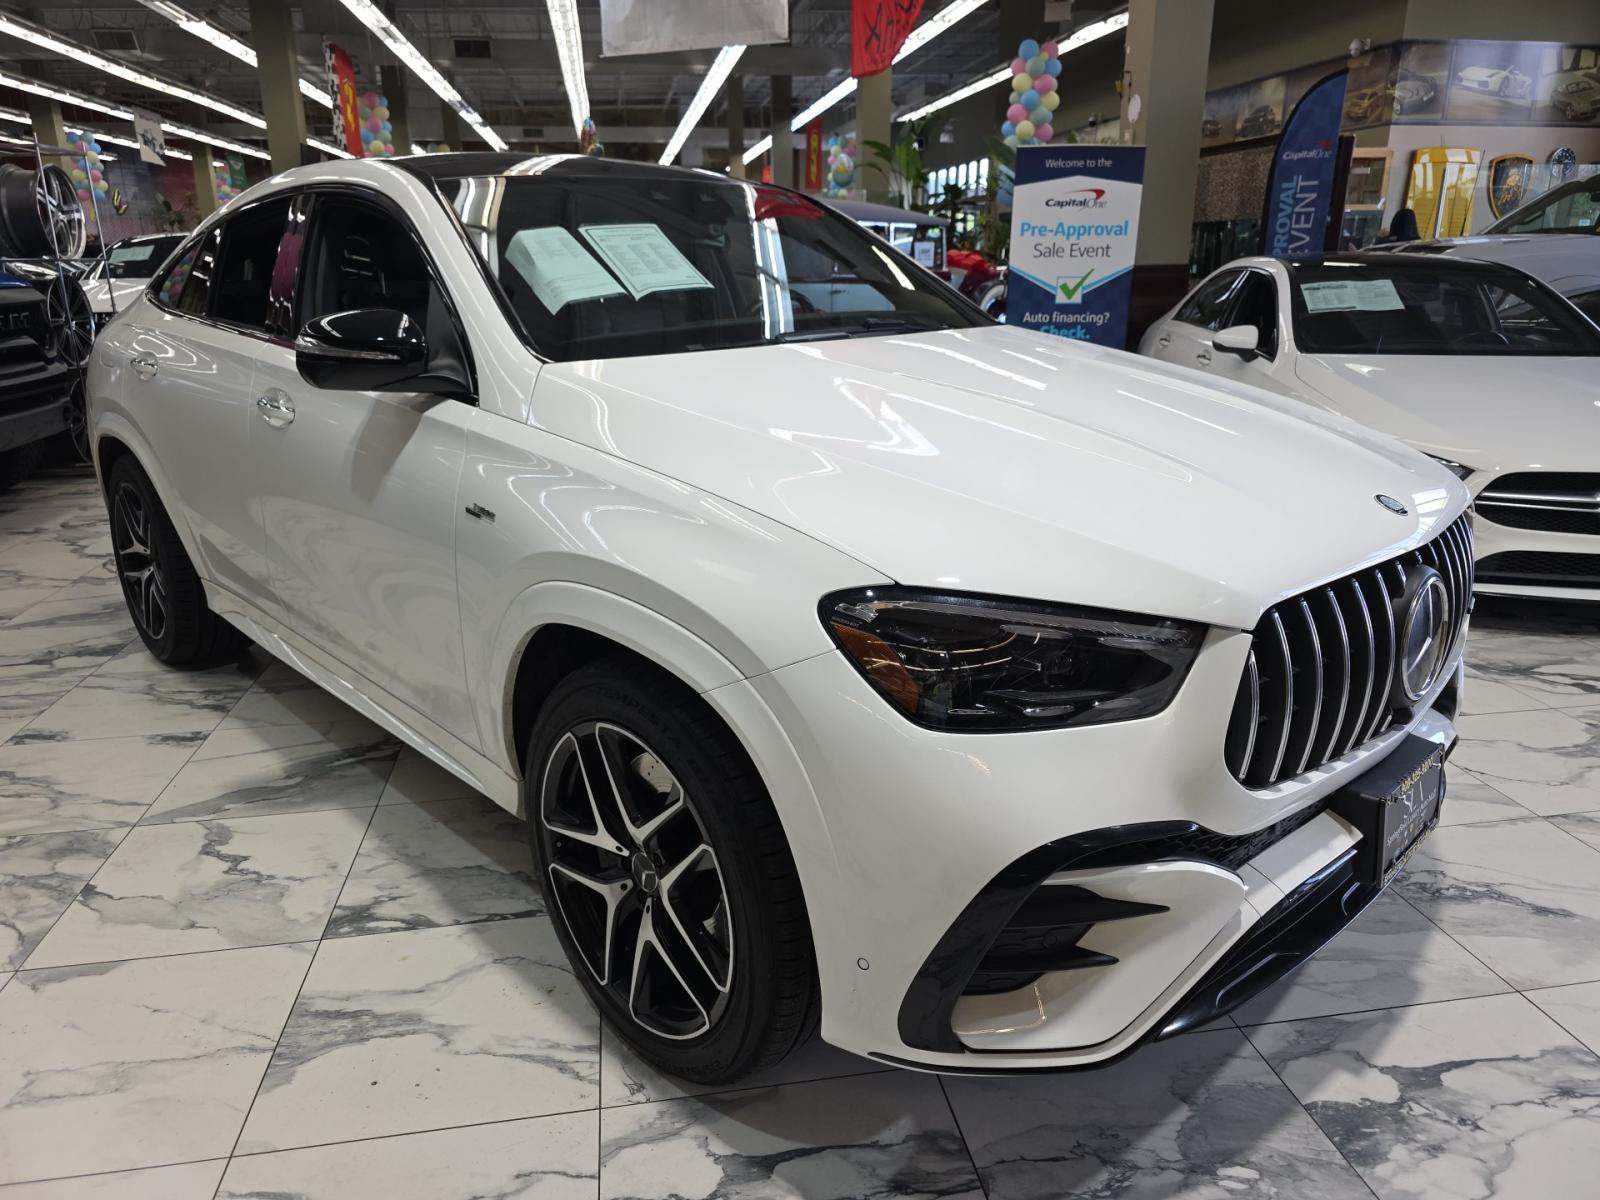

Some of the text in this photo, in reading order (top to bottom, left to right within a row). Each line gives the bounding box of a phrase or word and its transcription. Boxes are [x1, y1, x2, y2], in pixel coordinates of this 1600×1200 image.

[1045, 157, 1113, 168] Welcome to the
[1288, 175, 1319, 256] VENT
[1020, 220, 1129, 241] Pre-Approval
[1033, 243, 1112, 258] Sale Event
[1023, 311, 1110, 326] Auto financing?
